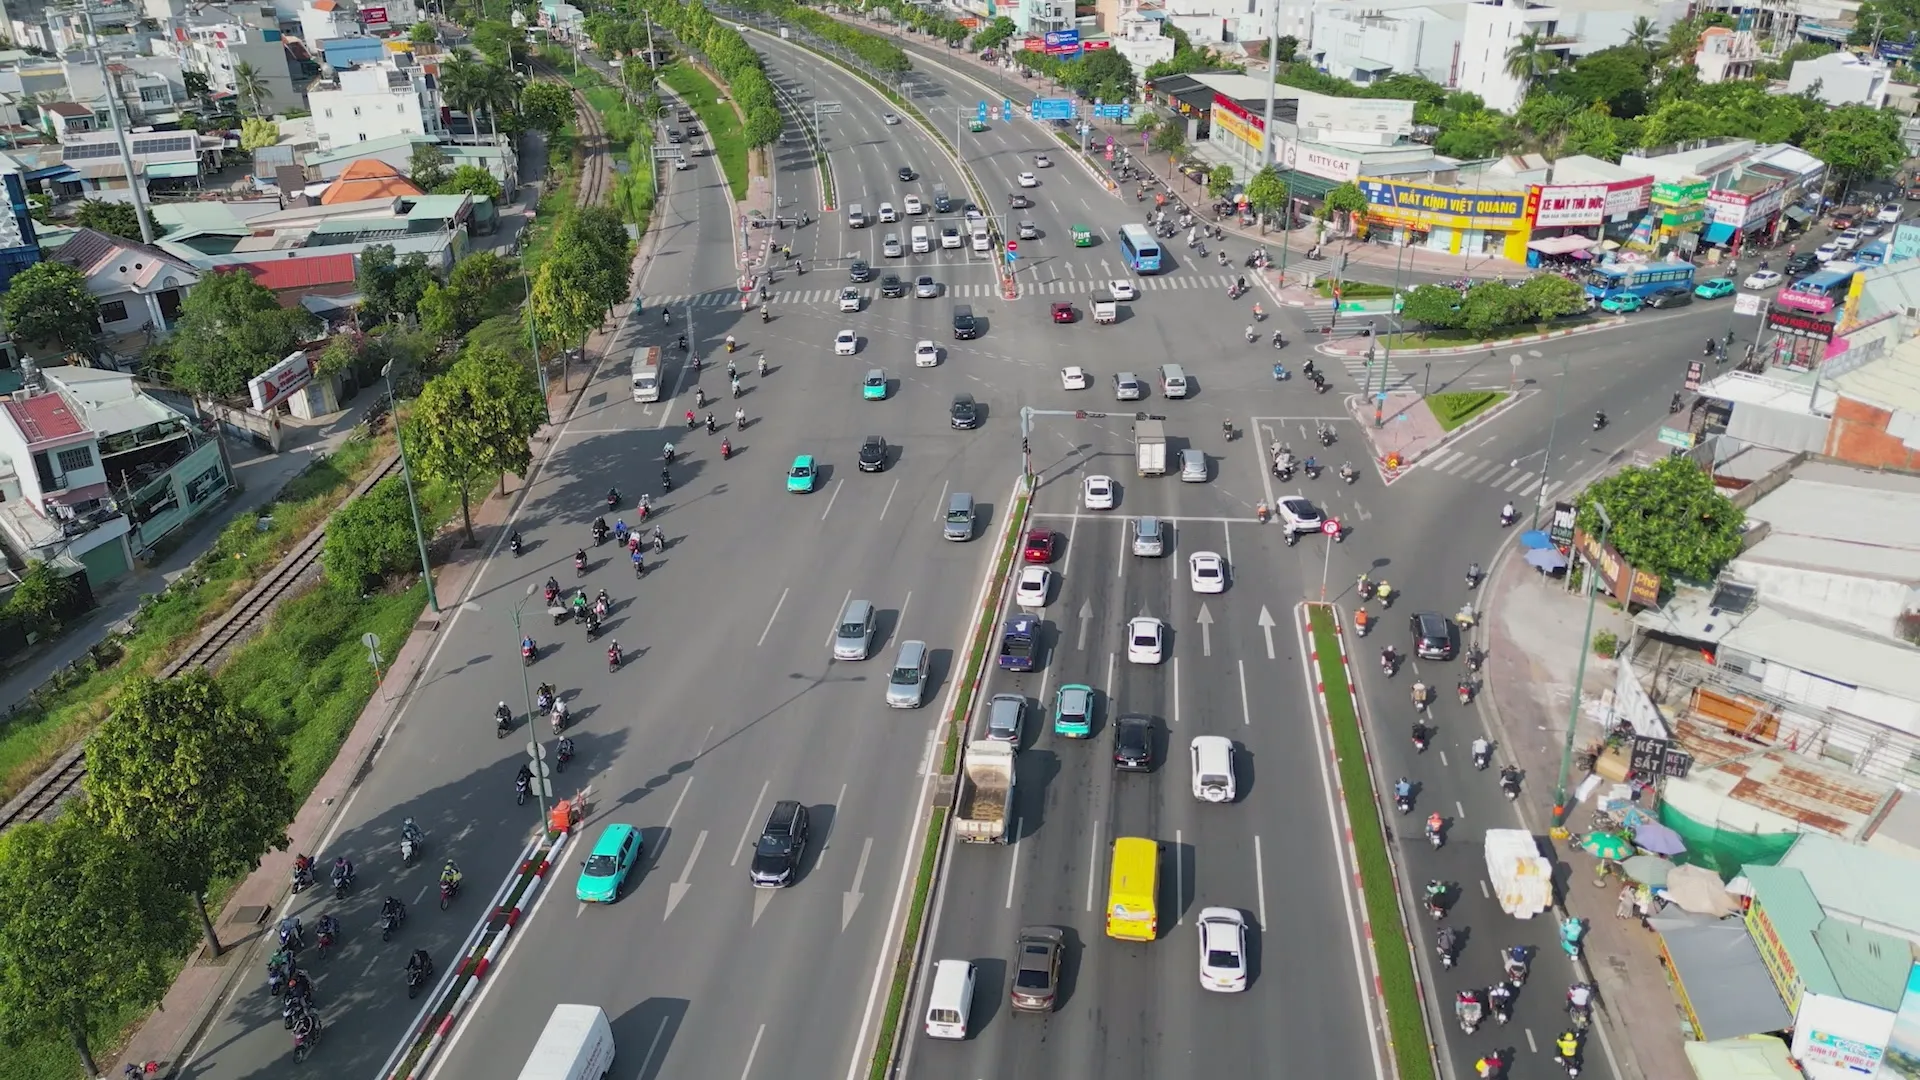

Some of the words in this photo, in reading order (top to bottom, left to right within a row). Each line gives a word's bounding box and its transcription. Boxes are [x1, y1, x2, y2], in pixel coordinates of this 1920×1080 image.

[1308, 154, 1332, 166] KITTY
[1332, 160, 1350, 171] CAT
[1399, 189, 1420, 206] MẮT
[1422, 193, 1448, 210] KÍNH
[1450, 197, 1474, 215] VIỆT
[1476, 200, 1518, 214] QUANG
[1542, 199, 1553, 210] XE
[1553, 195, 1571, 210] MÁY
[1572, 193, 1587, 209] THỦ
[1588, 194, 1605, 209] ĐỨC
[1636, 740, 1663, 755] KÉT
[1634, 755, 1660, 771] SẮT
[1667, 753, 1686, 765] KÉT
